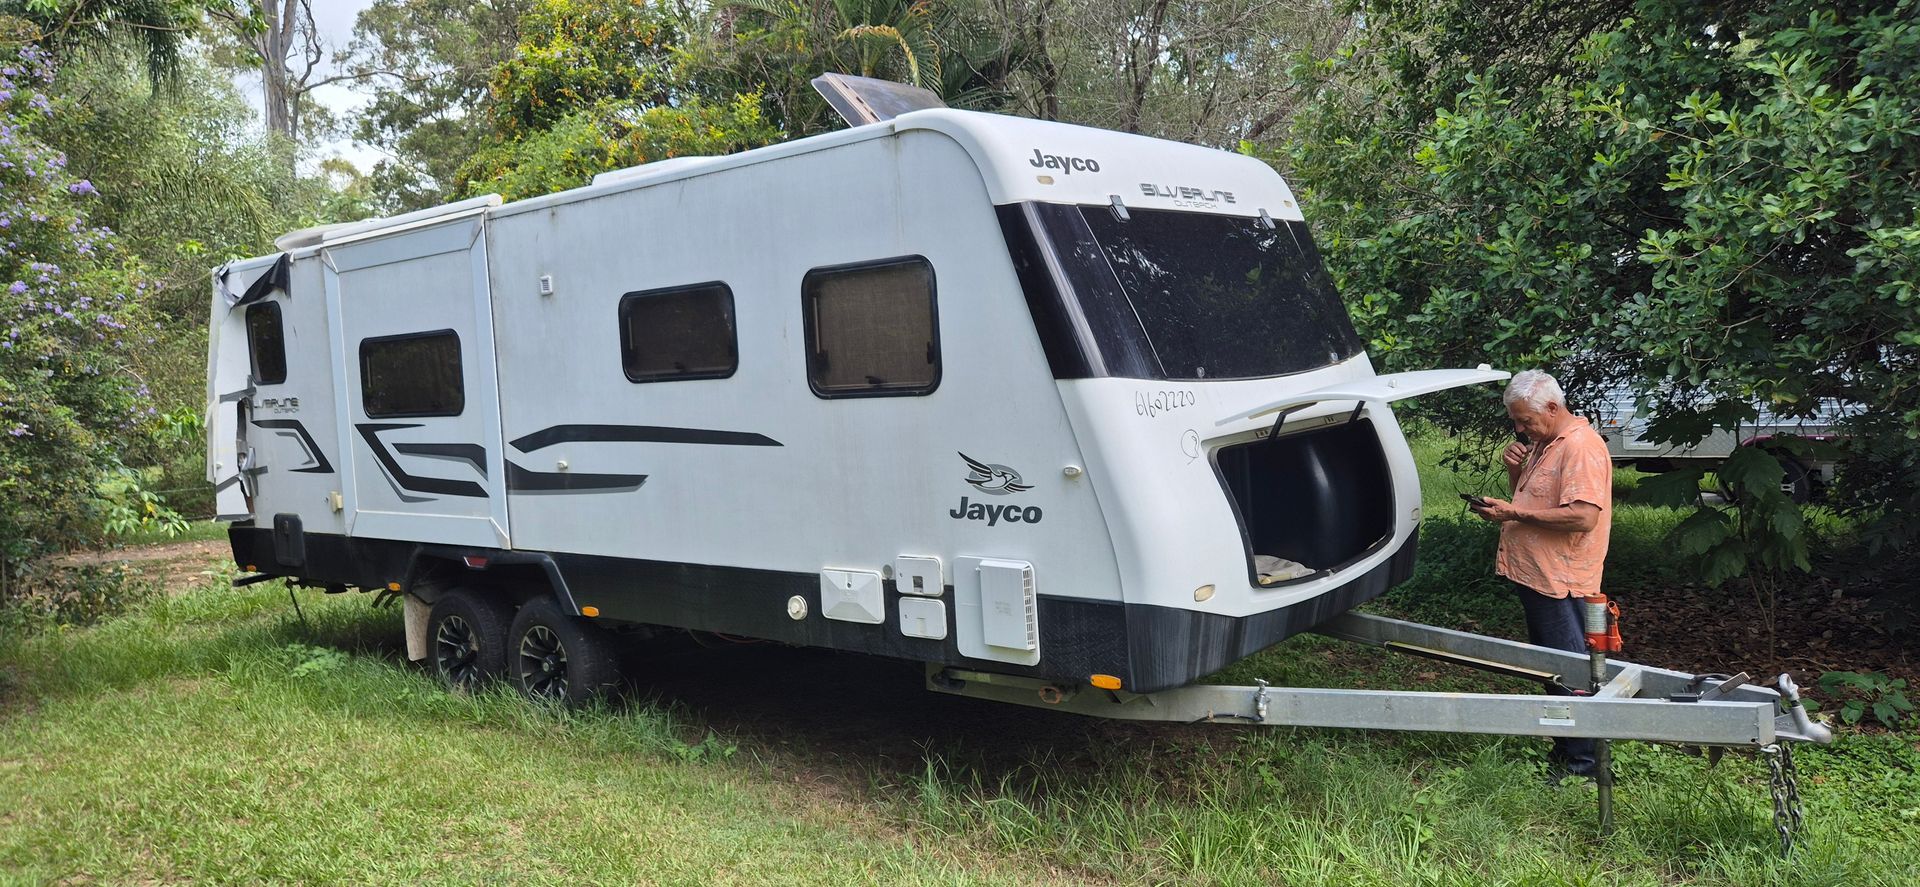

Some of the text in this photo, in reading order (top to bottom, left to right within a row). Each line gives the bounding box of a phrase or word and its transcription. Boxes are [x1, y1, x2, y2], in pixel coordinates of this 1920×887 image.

[1029, 149, 1100, 175] Jayco
[1139, 183, 1236, 204] SILVERLINE
[1173, 200, 1218, 209] OUTBACK
[949, 496, 1043, 527] Jayco
